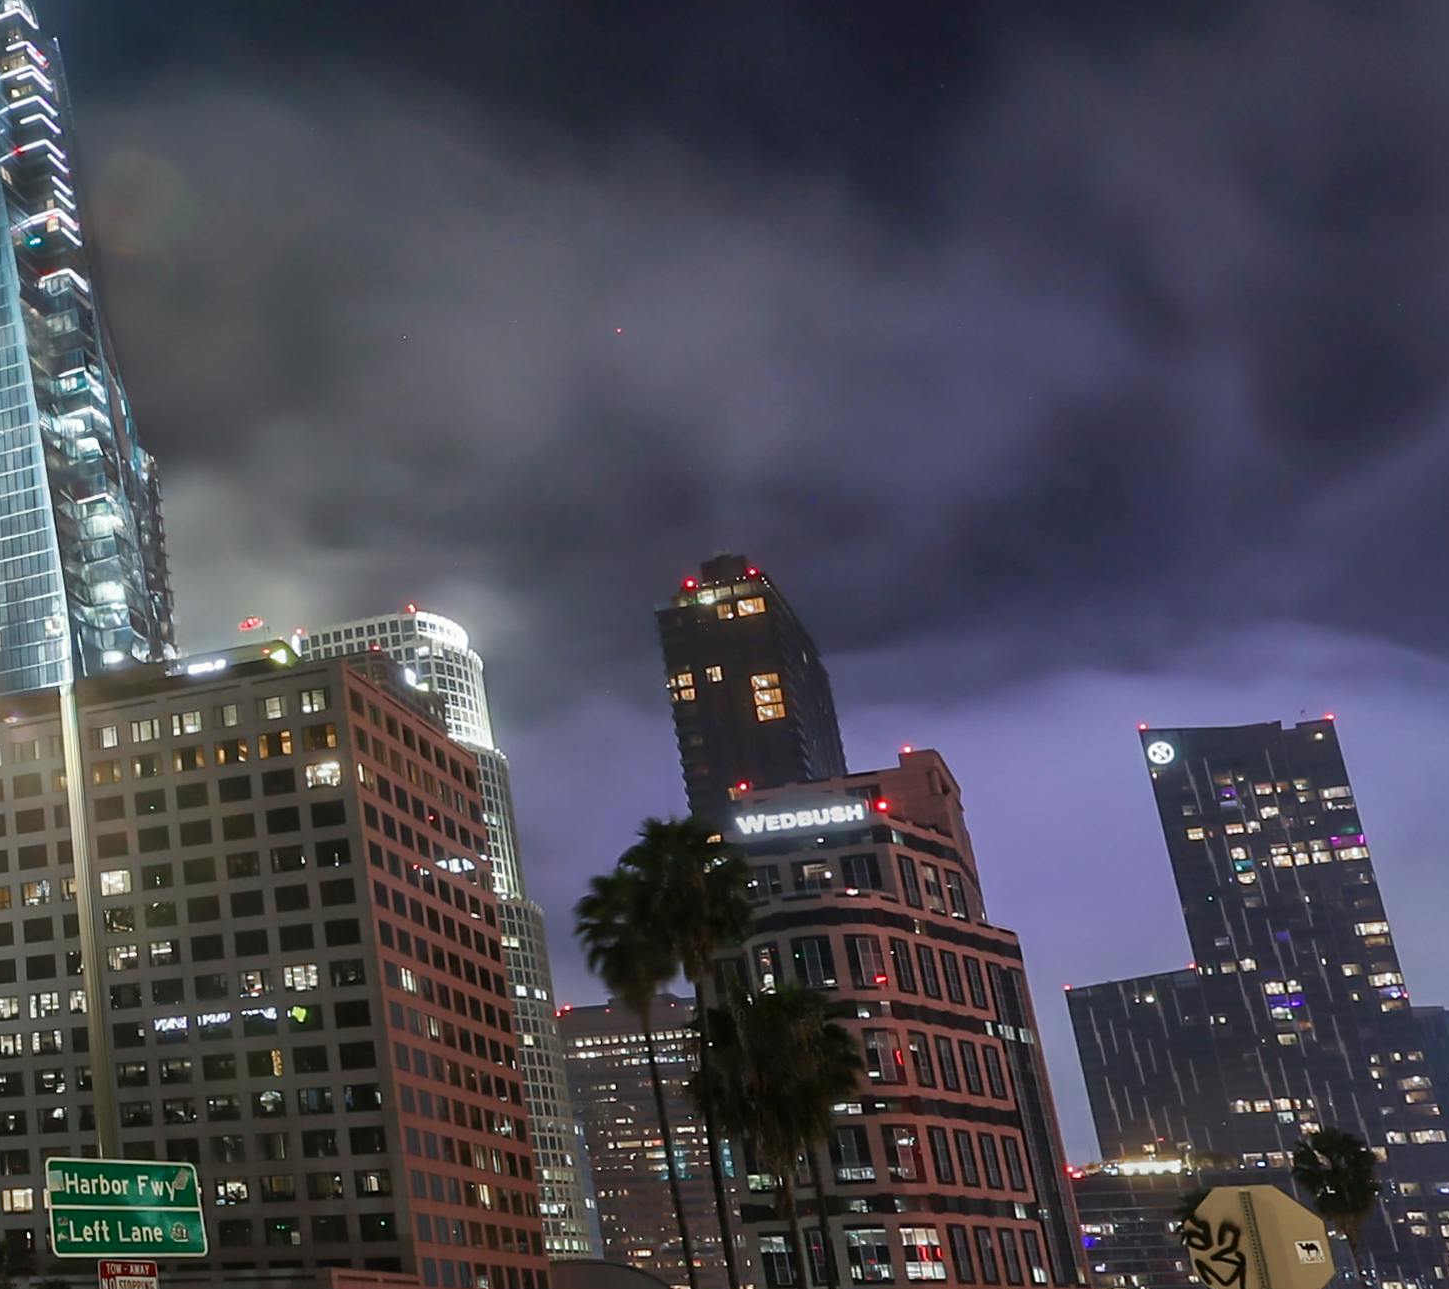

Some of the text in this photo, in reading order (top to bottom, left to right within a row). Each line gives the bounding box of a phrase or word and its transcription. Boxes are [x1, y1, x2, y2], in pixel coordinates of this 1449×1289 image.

[735, 803, 865, 835] WEDBUSH
[64, 1172, 176, 1202] Harbor Fwy
[69, 1220, 163, 1243] Left Lane
